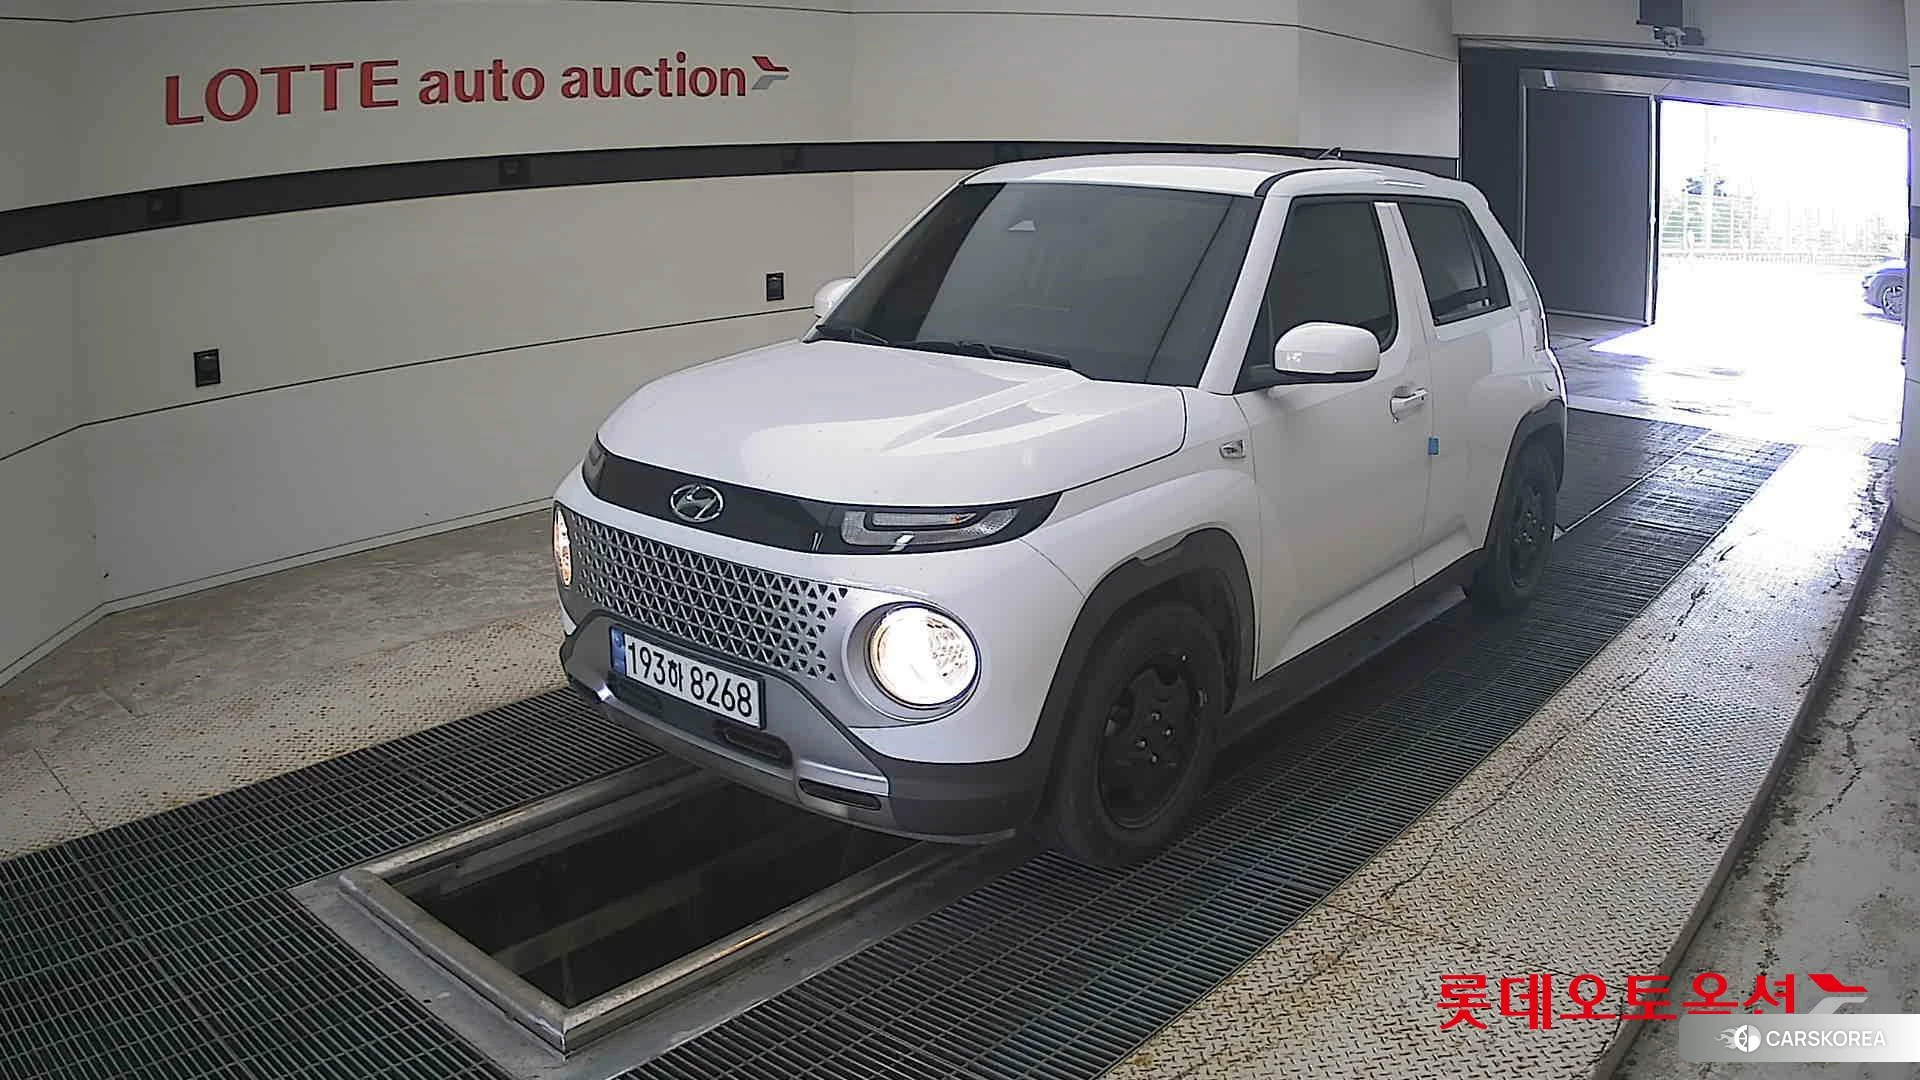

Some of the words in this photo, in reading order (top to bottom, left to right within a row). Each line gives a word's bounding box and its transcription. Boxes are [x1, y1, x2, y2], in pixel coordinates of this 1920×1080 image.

[165, 59, 400, 126] LOTTE
[418, 58, 546, 105] auto
[560, 51, 748, 98] auction
[628, 641, 684, 692] 193하
[690, 666, 752, 717] 8268
